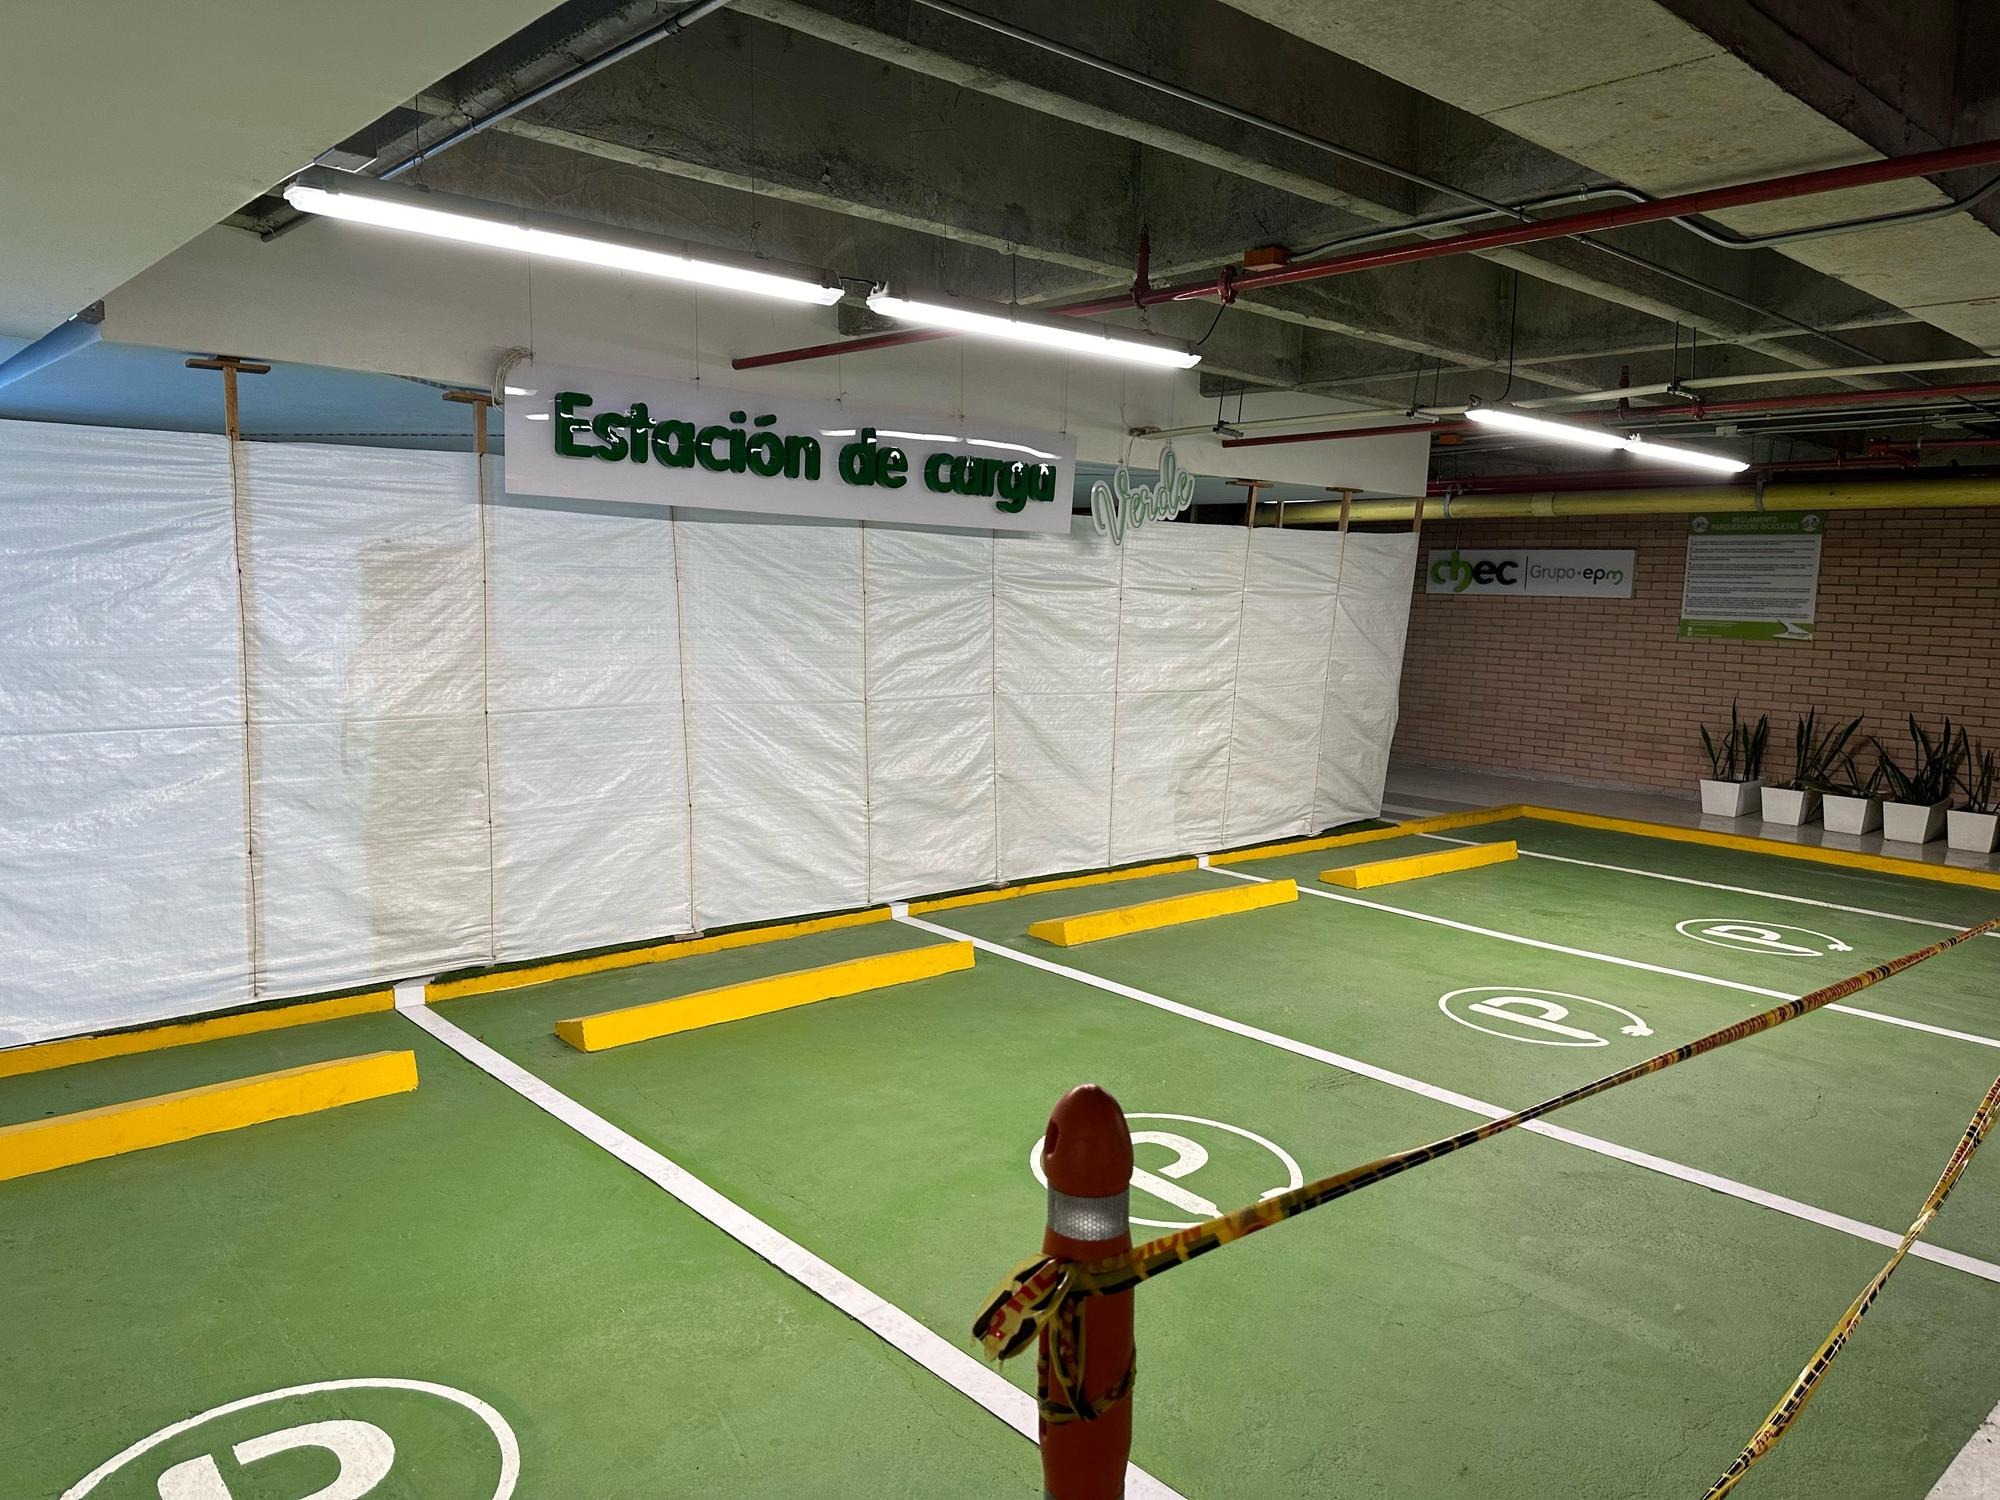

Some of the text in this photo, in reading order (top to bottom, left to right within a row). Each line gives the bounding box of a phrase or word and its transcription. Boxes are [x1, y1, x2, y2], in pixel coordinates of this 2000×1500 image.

[554, 391, 1057, 514] Estación de carga
[1093, 448, 1195, 547] Verde
